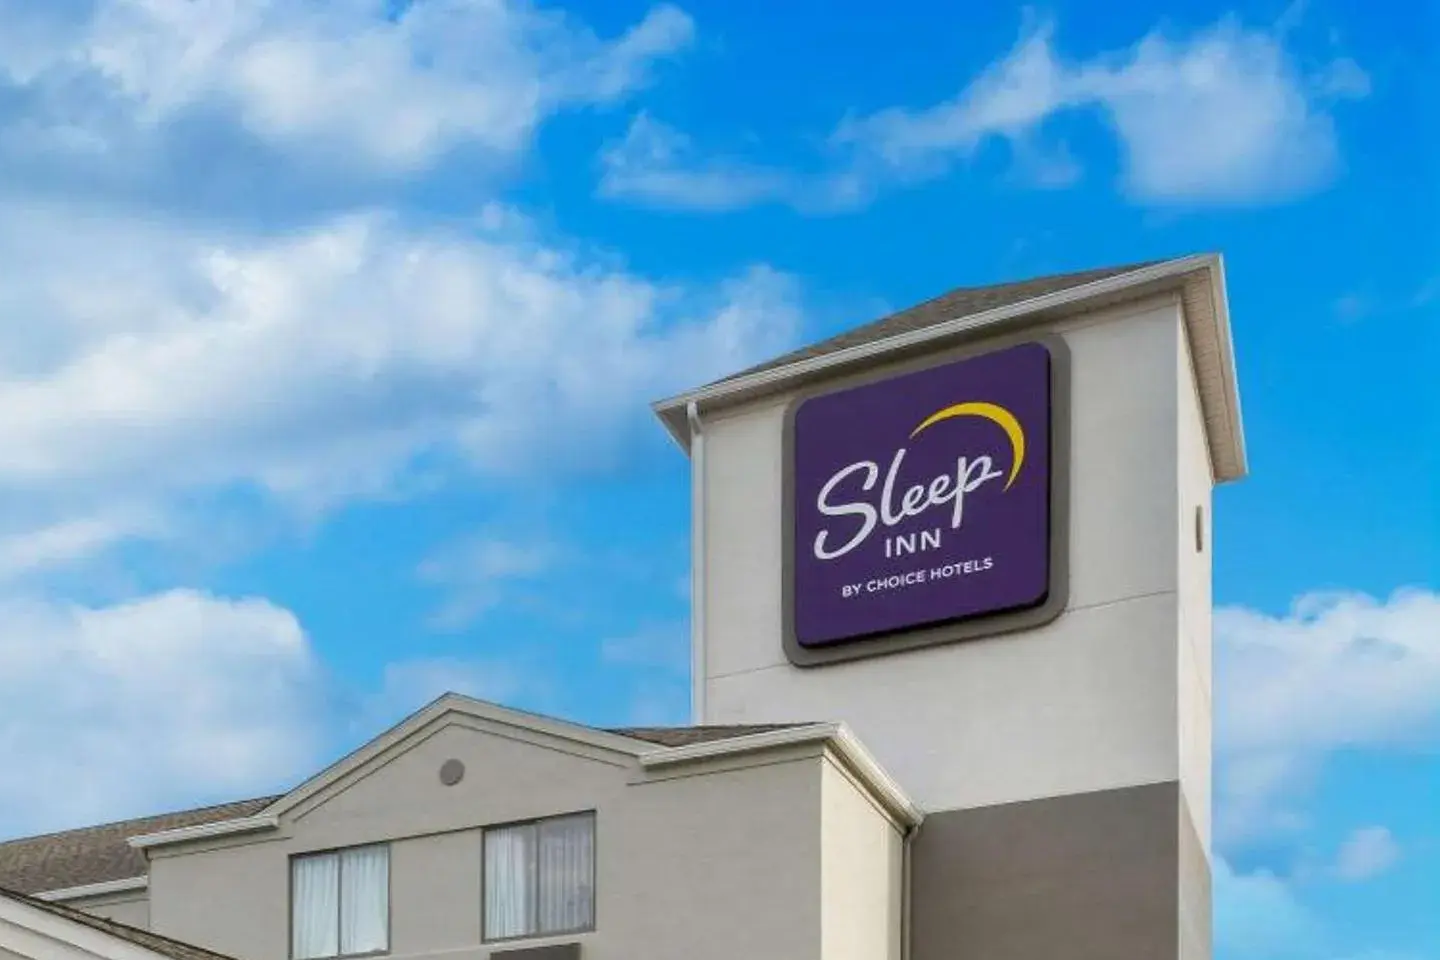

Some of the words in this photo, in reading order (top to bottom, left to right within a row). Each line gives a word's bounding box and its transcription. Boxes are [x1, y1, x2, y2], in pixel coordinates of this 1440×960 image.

[813, 448, 1003, 560] Sleep
[885, 528, 941, 558] INN
[841, 583, 862, 598] BY
[866, 569, 926, 593] CHOICE
[930, 557, 994, 580] HOTELS
